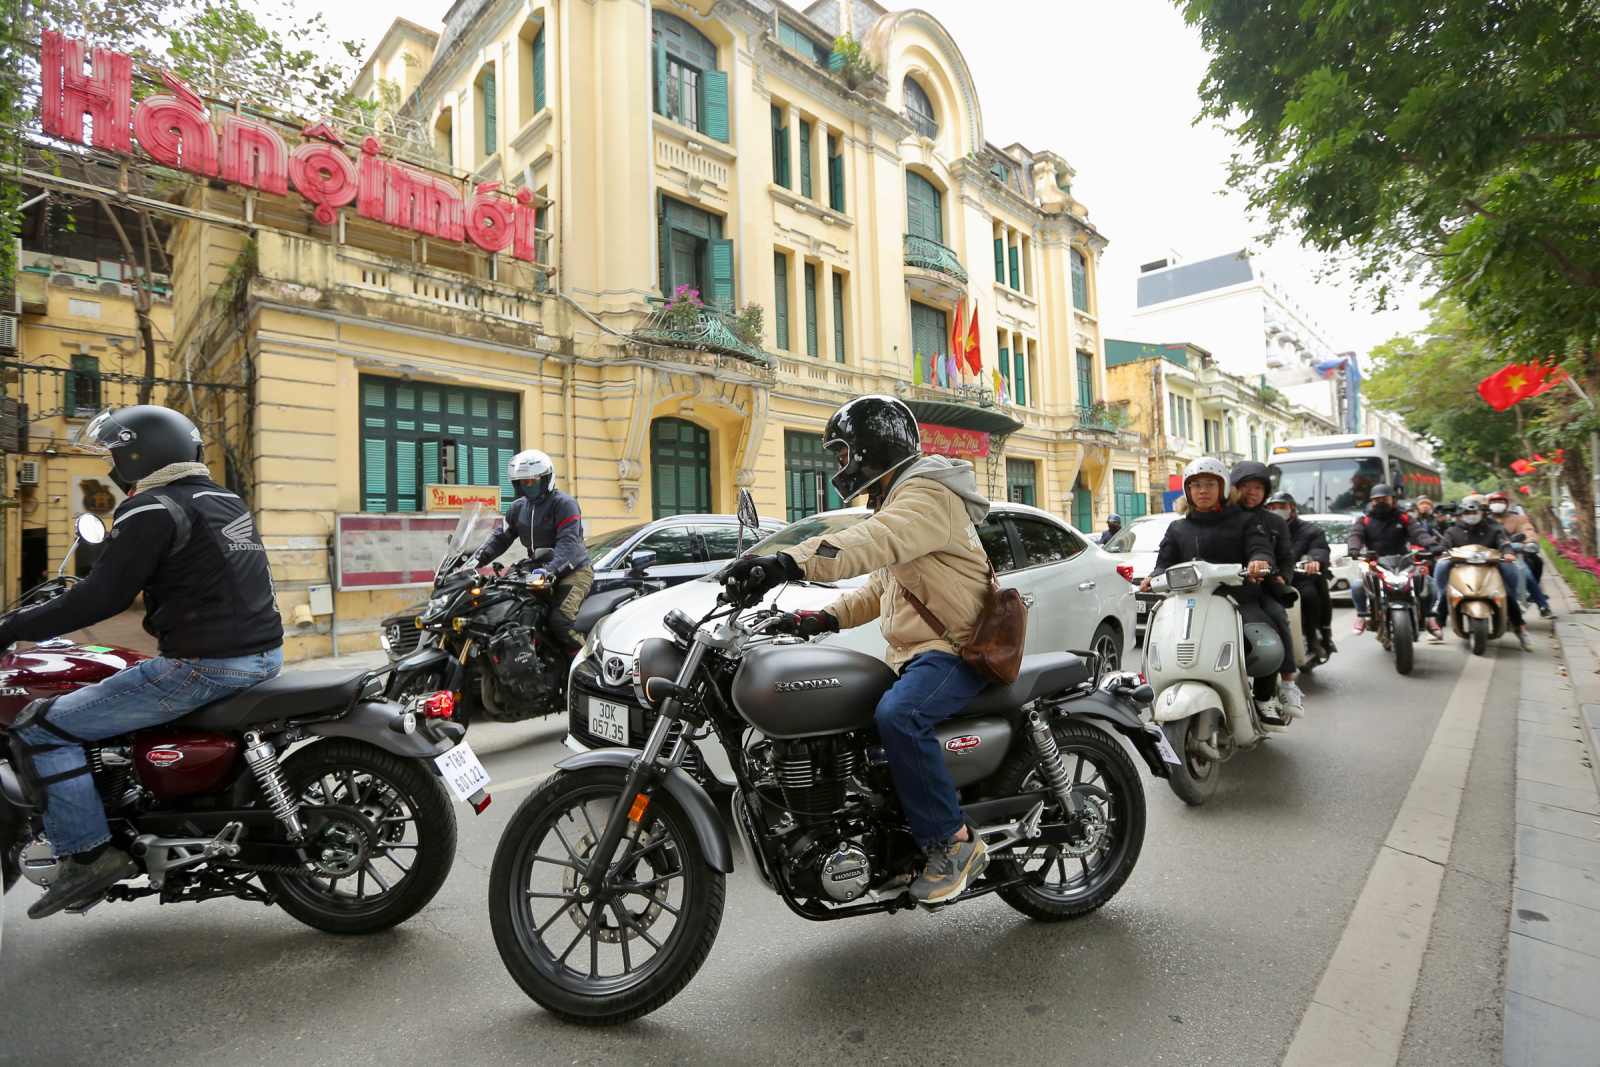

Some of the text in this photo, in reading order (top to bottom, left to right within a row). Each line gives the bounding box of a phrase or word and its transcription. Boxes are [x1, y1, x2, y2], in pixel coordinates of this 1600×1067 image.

[776, 678, 840, 692] HONDA
[599, 702, 616, 720] 30K
[593, 718, 624, 741] 057.35
